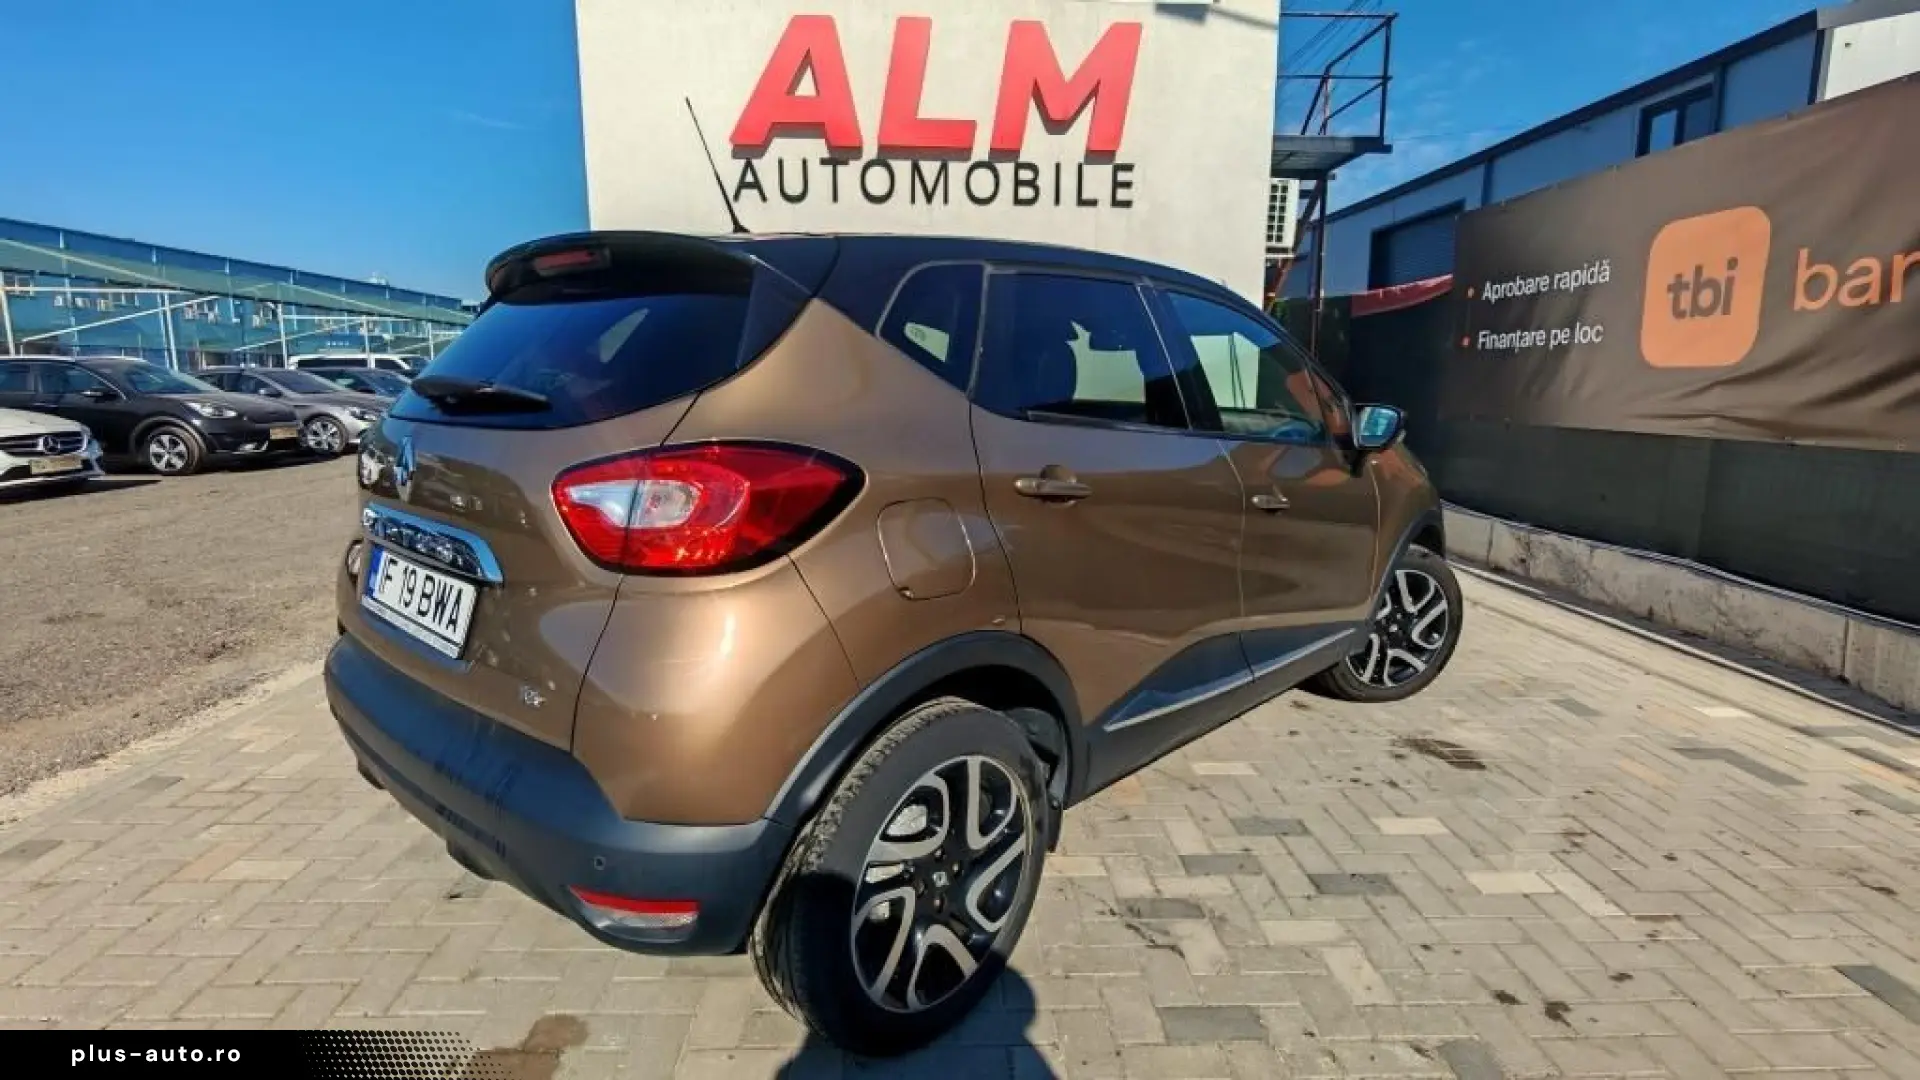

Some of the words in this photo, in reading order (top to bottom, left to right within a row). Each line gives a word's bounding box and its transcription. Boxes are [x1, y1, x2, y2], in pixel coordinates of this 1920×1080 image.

[729, 14, 1143, 164] ALM
[733, 158, 1135, 208] AUTOMOBILE
[1482, 275, 1550, 304] Aprobare
[1553, 258, 1611, 293] rapidă
[1667, 256, 1739, 320] tbi
[1549, 326, 1570, 350] pe
[1574, 321, 1604, 344] loc
[399, 565, 417, 608] 19
[417, 573, 464, 633] BWA
